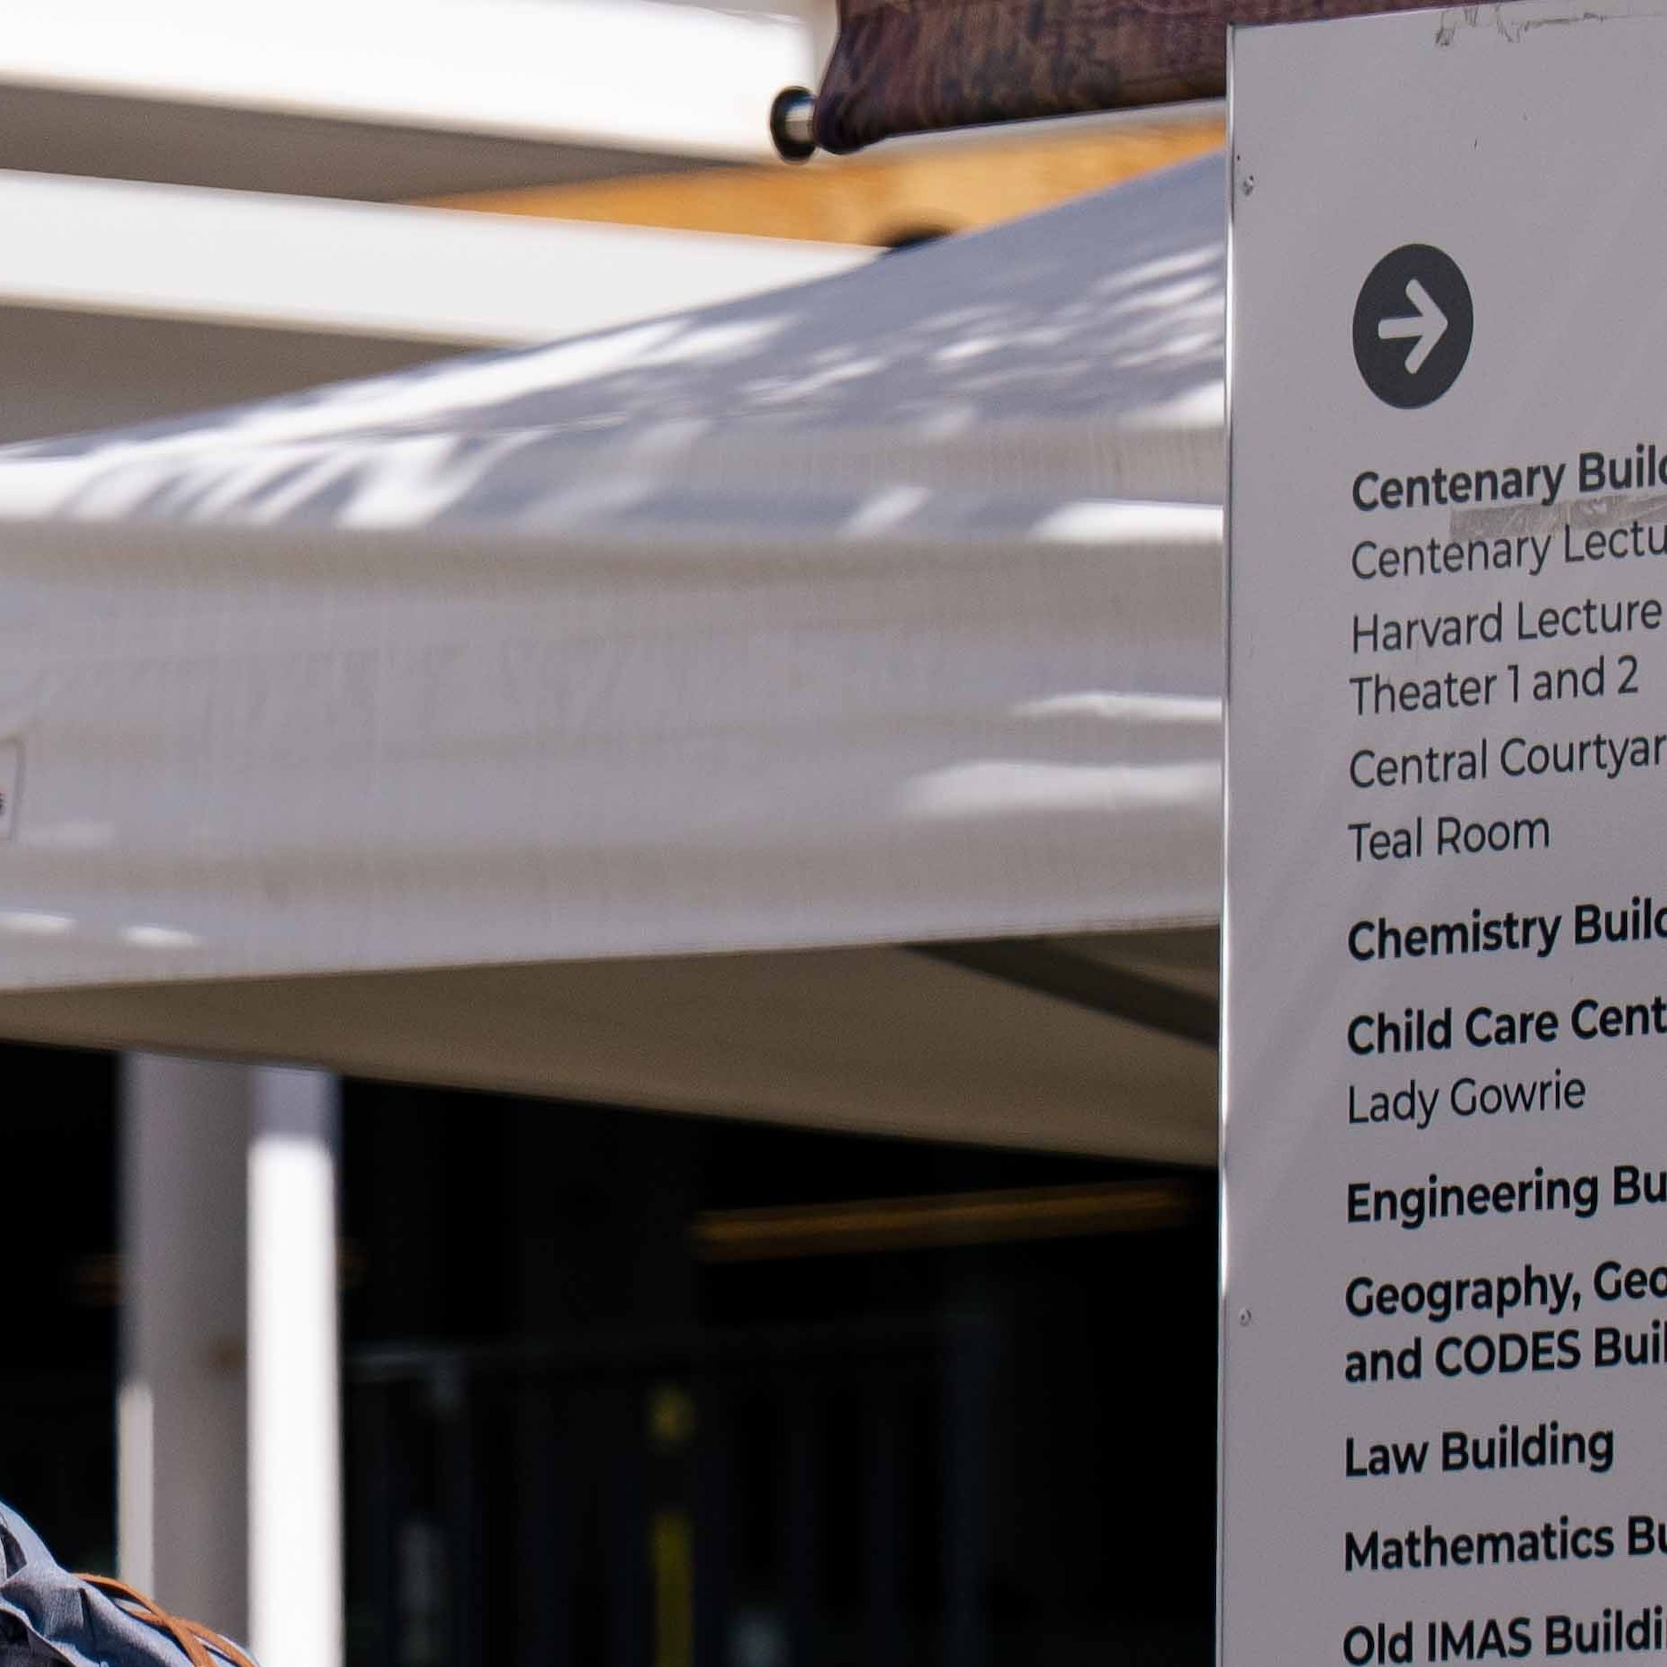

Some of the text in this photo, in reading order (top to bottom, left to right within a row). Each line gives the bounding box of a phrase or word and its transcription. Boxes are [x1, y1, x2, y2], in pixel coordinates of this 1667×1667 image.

[1352, 462, 1567, 513] Centenary
[1351, 518, 1667, 581] Centenary Lectu
[1352, 598, 1663, 655] Harvard Lecture
[1348, 654, 1639, 716] Theater 1 and 2
[1349, 733, 1667, 789] Central Courtyar
[1347, 815, 1550, 863] Teal Room
[1347, 907, 1563, 962] Chemistry
[1346, 995, 1667, 1057] Child Care Cent
[1348, 1067, 1587, 1131] Lady Gowrie
[1347, 1164, 1667, 1231] Engineering Bu
[1345, 1259, 1667, 1324] Geography, Geo
[1344, 1335, 1423, 1384] and
[1435, 1328, 1582, 1378] CODES
[1345, 1419, 1615, 1478] Law Building
[1344, 1514, 1615, 1573] Mathematics
[1342, 1604, 1667, 1667] Old IMAS Buildi
